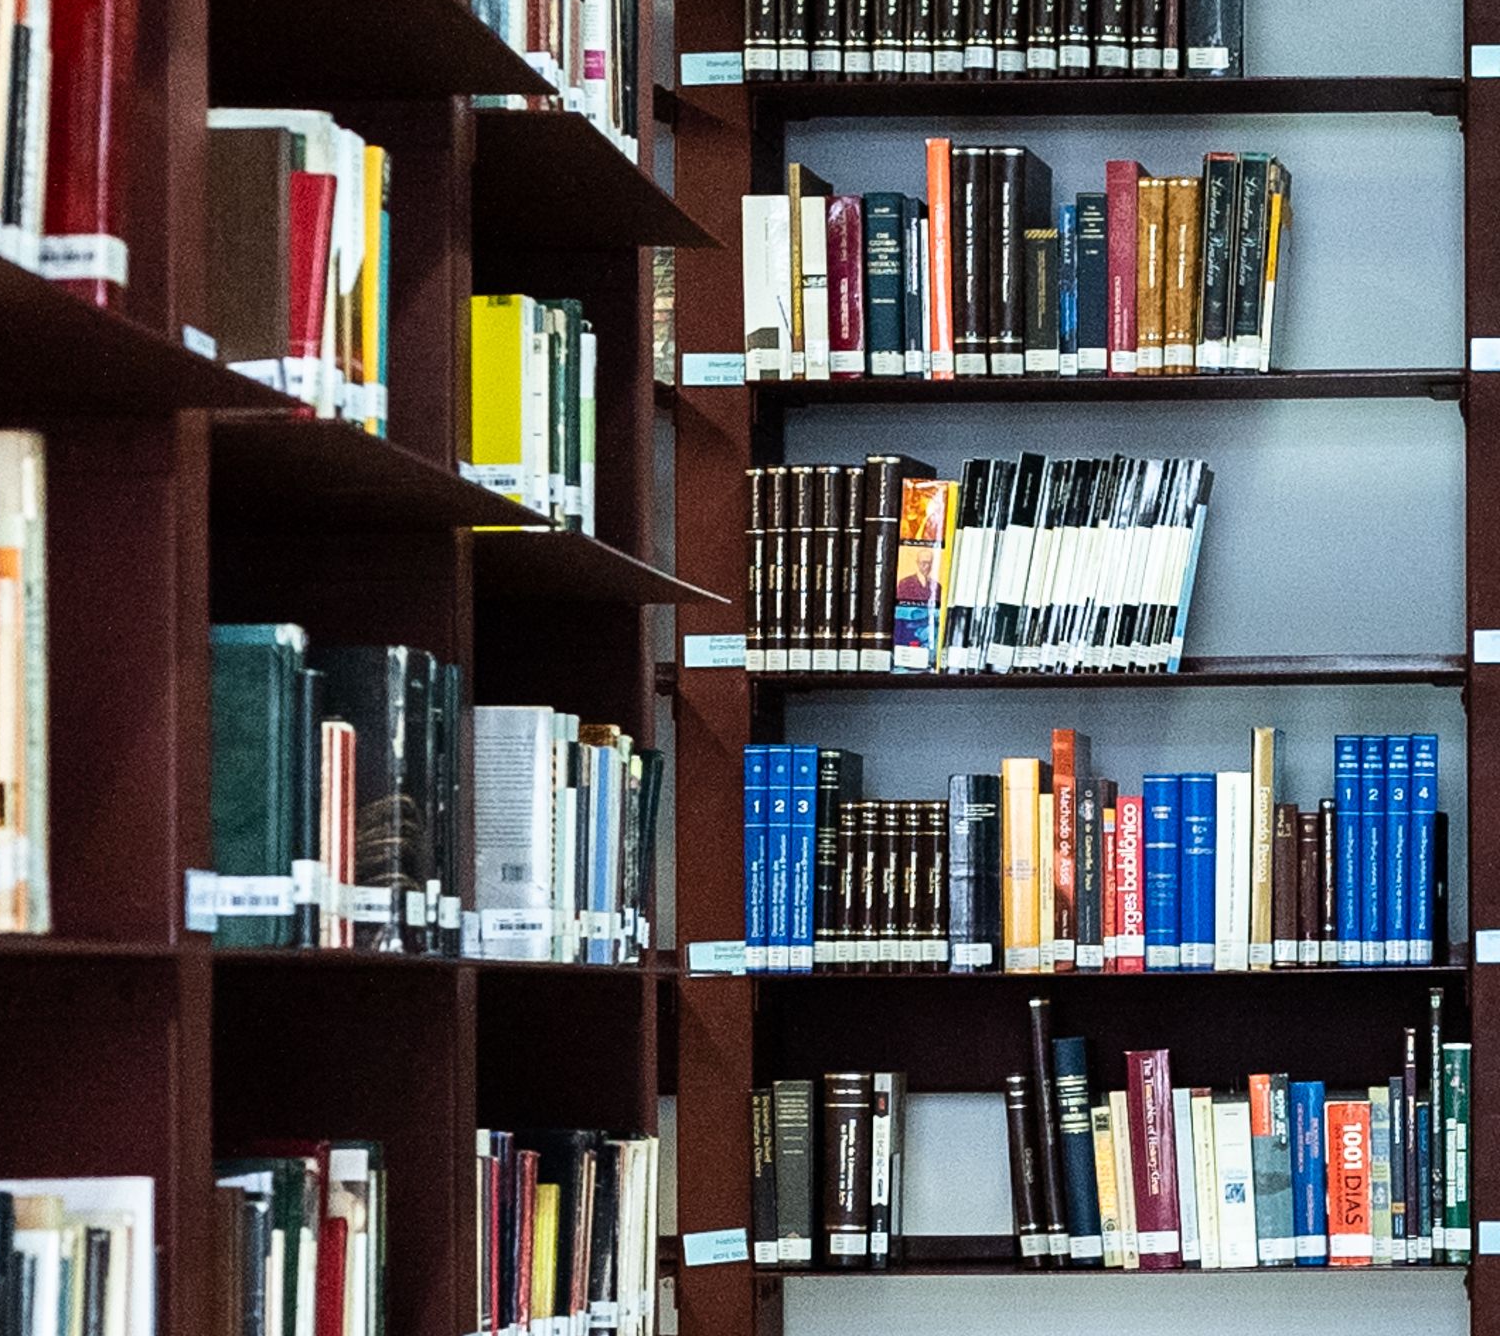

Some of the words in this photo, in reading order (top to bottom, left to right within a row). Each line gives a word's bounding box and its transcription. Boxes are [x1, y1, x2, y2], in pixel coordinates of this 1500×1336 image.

[774, 799, 786, 815] 2
[797, 799, 809, 815] 3
[1059, 786, 1071, 839] Machado
[1257, 786, 1271, 841] Fernando
[1059, 840, 1071, 856] de
[1116, 802, 1138, 892] babilônico
[1059, 857, 1071, 887] Assis
[1120, 891, 1143, 937] orges
[1342, 1122, 1363, 1171] 1001
[1345, 1175, 1363, 1227] DIAS
